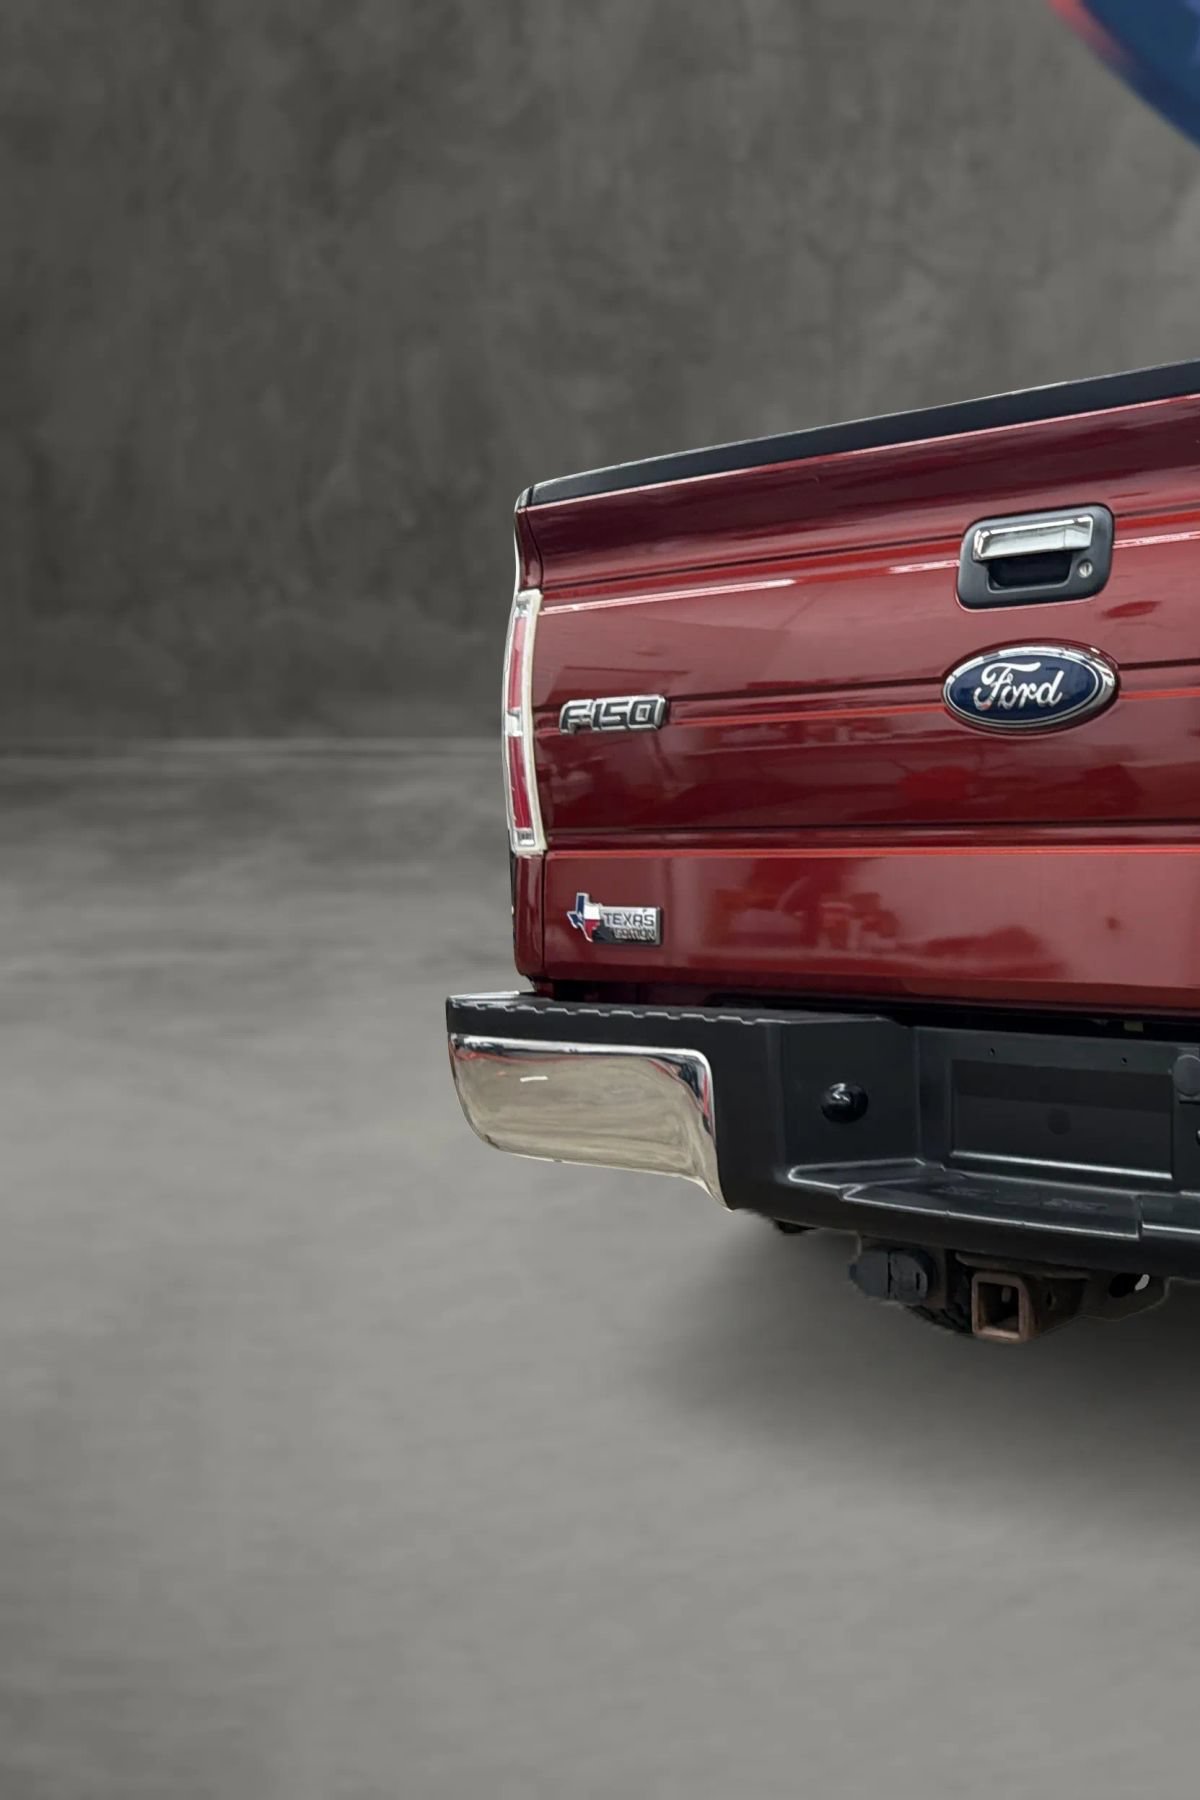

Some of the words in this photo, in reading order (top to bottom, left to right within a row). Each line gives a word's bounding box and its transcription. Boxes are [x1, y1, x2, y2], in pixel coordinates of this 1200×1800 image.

[973, 661, 1065, 712] Ford
[559, 694, 666, 734] F-150
[603, 912, 655, 927] TEXAS
